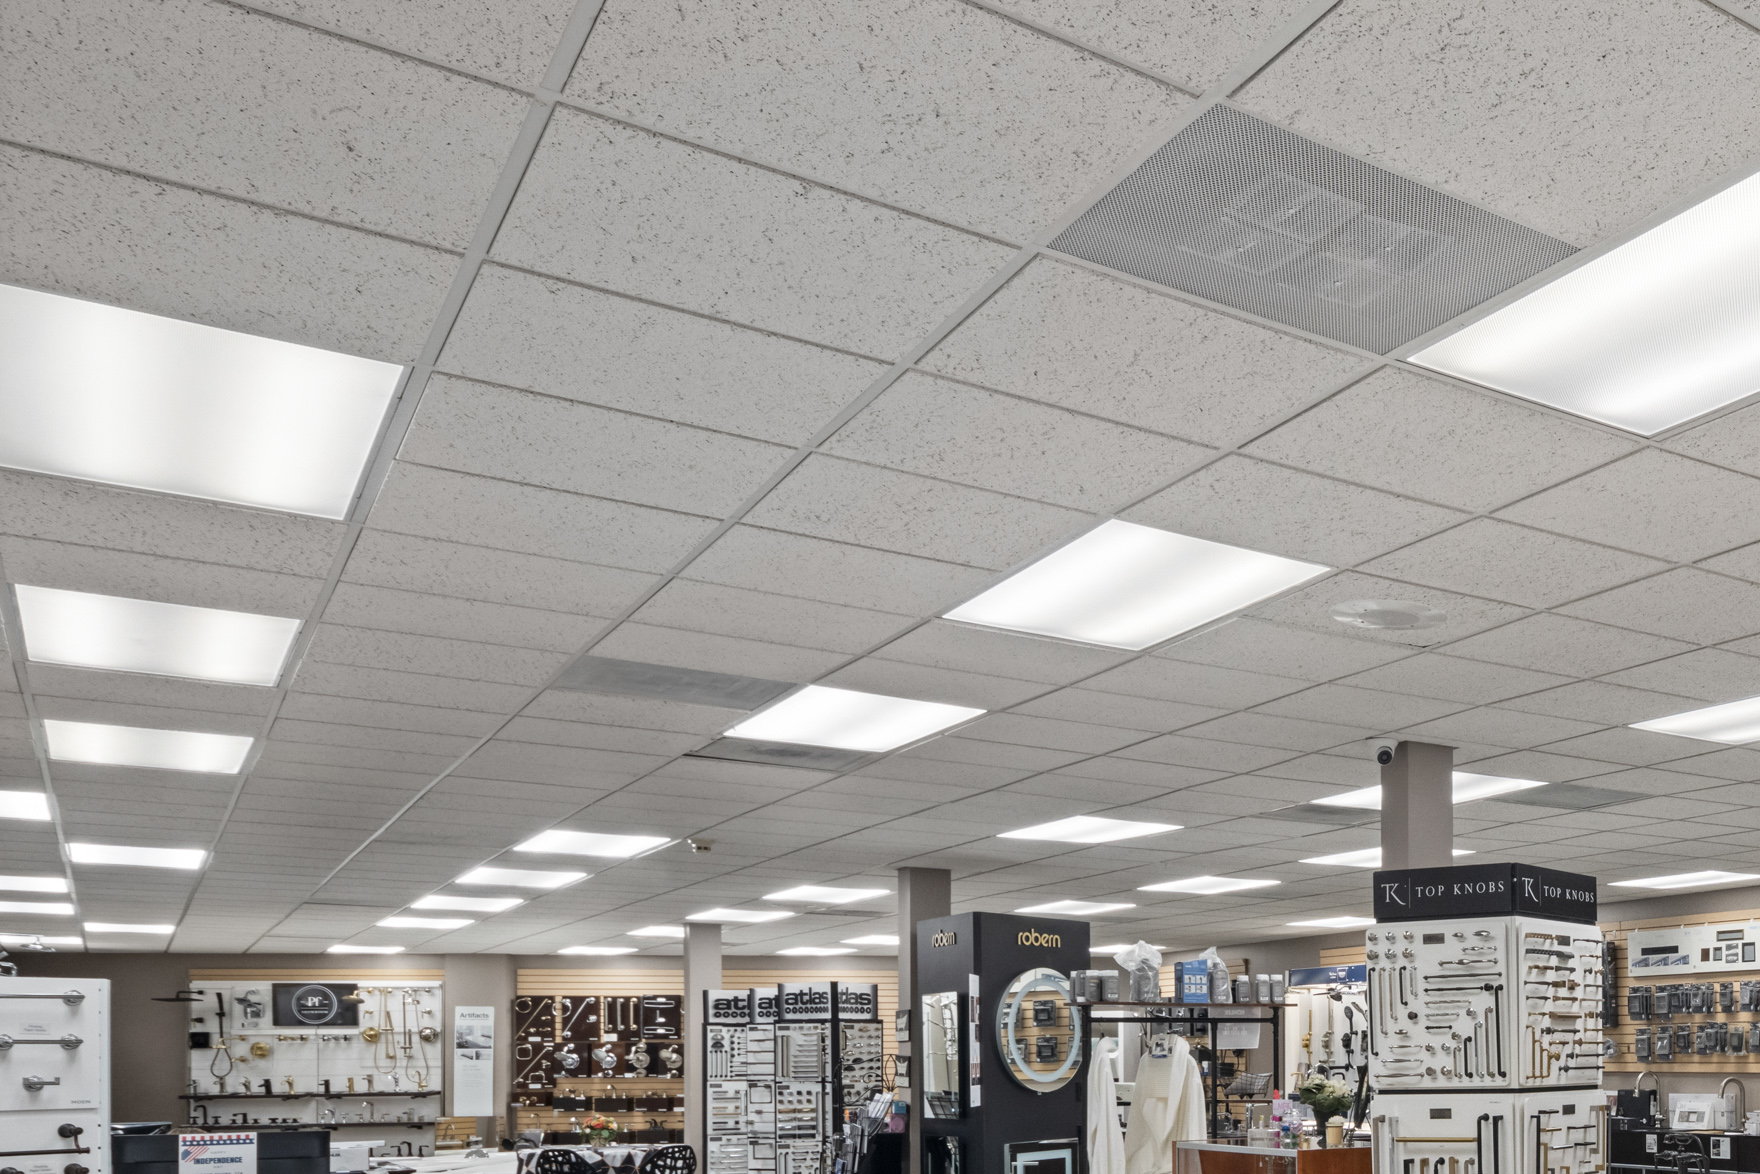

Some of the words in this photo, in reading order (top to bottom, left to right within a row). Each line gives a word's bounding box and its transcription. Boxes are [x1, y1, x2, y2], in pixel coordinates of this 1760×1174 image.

[1416, 886, 1445, 898] TOP
[1453, 881, 1505, 895] KNOBS
[1544, 886, 1562, 899] TOP
[1566, 891, 1594, 903] KNOBS
[932, 929, 957, 948] robern
[1018, 929, 1061, 948] robern
[785, 987, 829, 1005] atlas
[838, 987, 872, 1005] tlas
[193, 1156, 243, 1164] INDEPENDENCE
